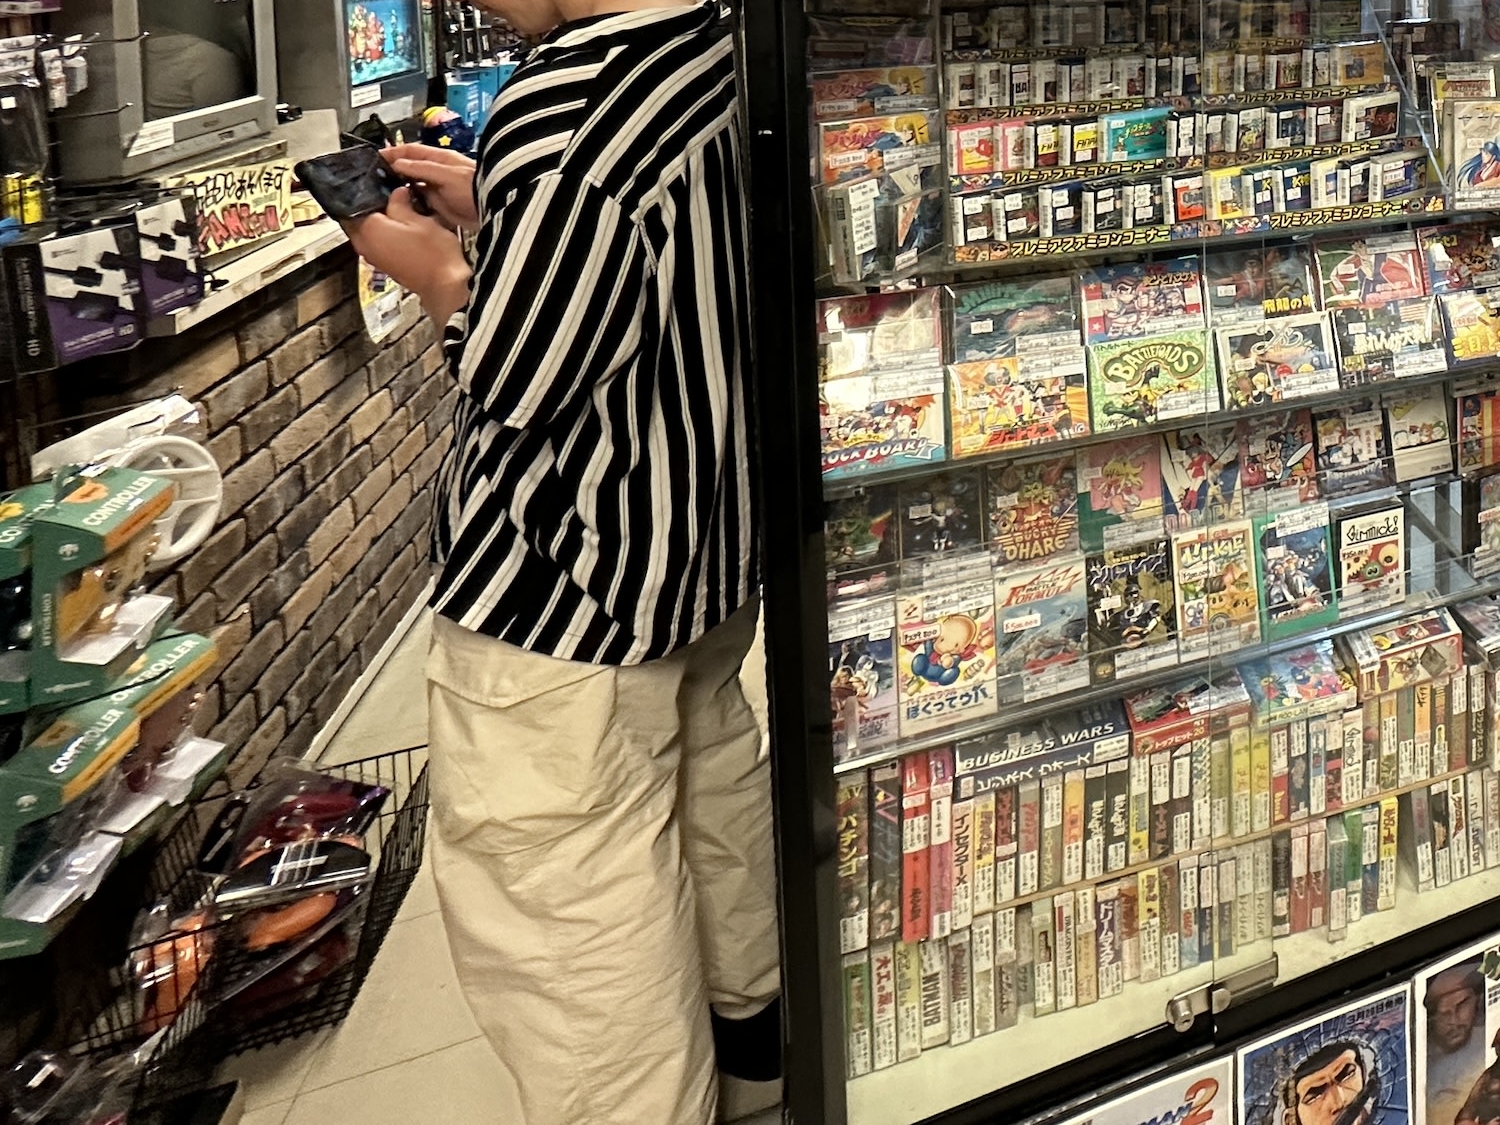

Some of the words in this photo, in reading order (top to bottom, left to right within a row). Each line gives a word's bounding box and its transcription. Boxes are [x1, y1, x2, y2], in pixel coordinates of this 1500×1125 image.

[1268, 204, 1403, 230] プレミアファミコンコーナー
[1010, 226, 1172, 257] プレミアファミコンコーナー
[27, 339, 41, 357] HD
[1108, 345, 1200, 386] BATTLETOADS
[863, 436, 929, 462] BOARD
[82, 476, 157, 527] CONTROLLER
[110, 638, 201, 704] ONTROLLER
[48, 707, 124, 774] CONTROLLER
[962, 737, 1056, 771] BUSINESS
[1060, 722, 1116, 747] WARS
[922, 971, 941, 1028] BATMAN
[1178, 1077, 1219, 1125] 2
